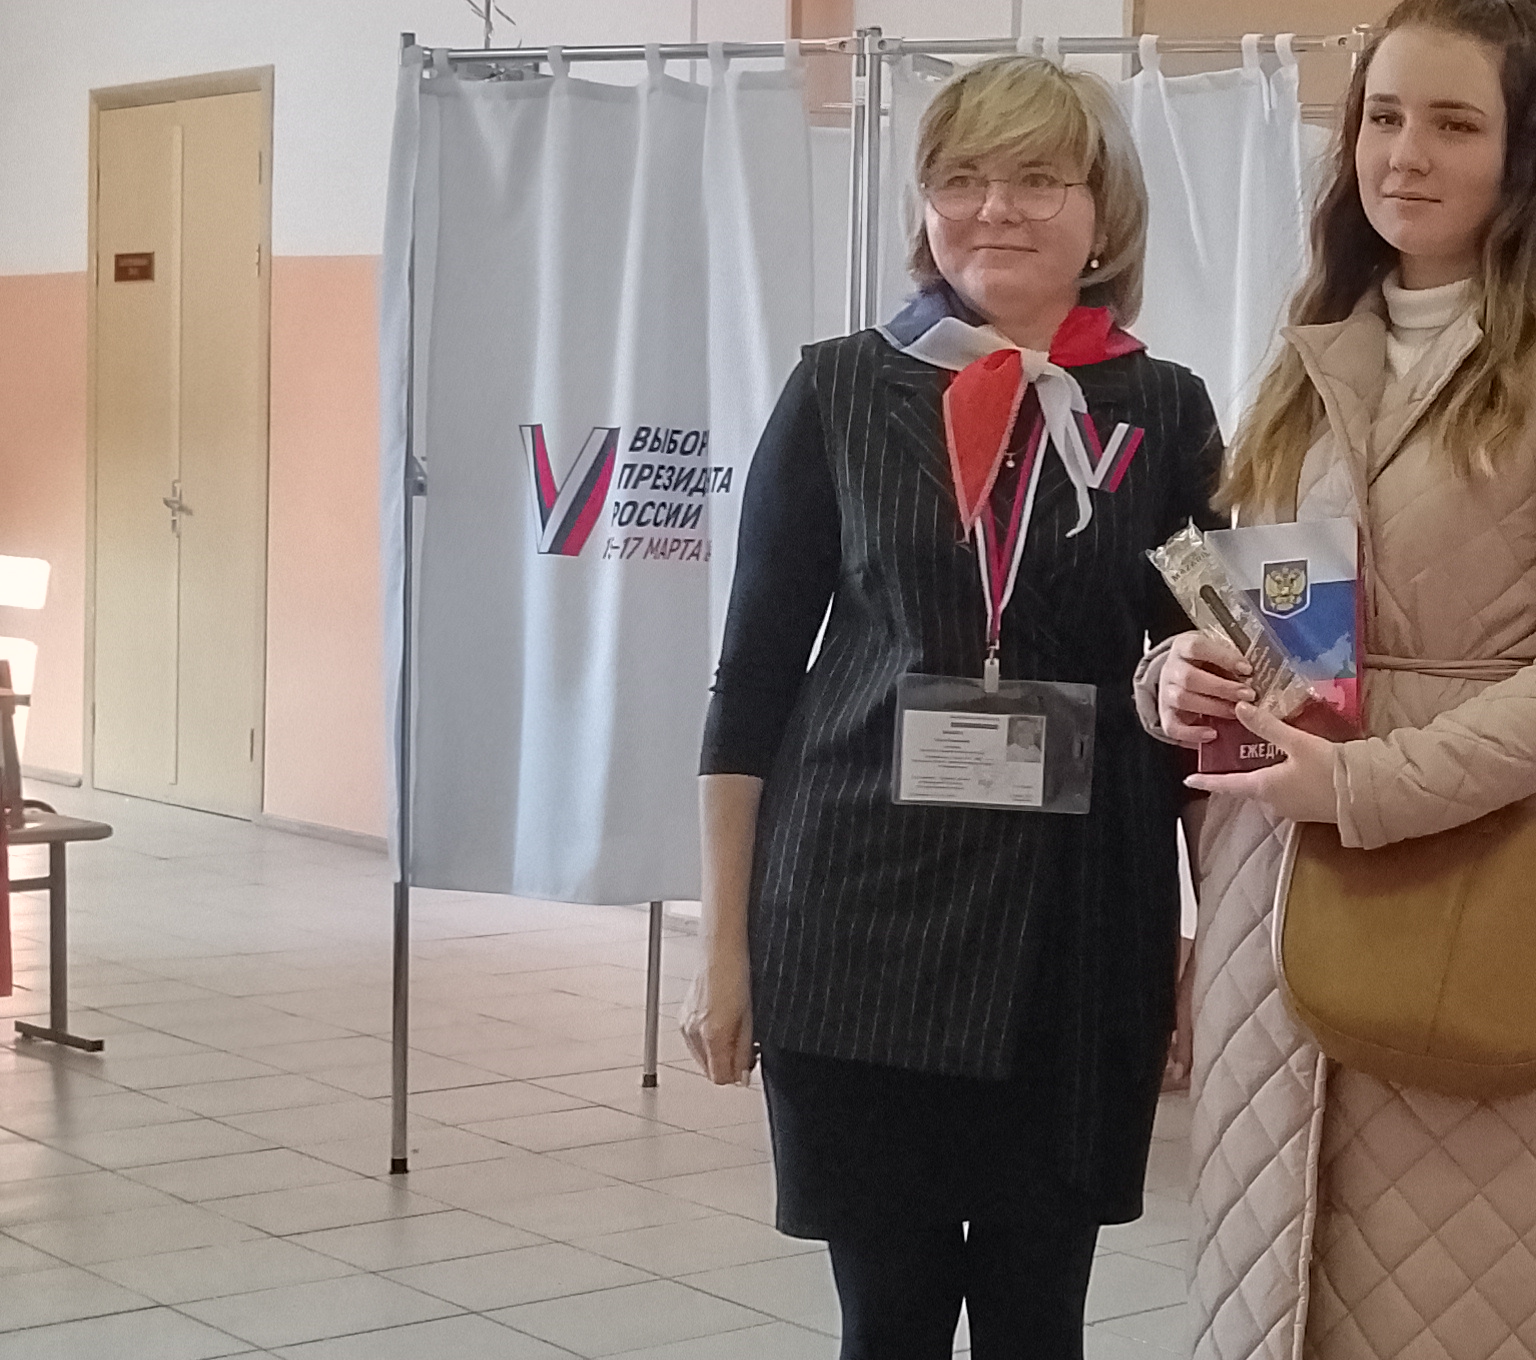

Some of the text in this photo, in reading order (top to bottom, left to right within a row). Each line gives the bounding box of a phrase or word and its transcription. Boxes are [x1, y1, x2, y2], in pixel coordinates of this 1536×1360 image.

[629, 426, 710, 457] ВЫБОР
[611, 500, 704, 529] РОССИИ
[643, 537, 703, 561] МАРТА
